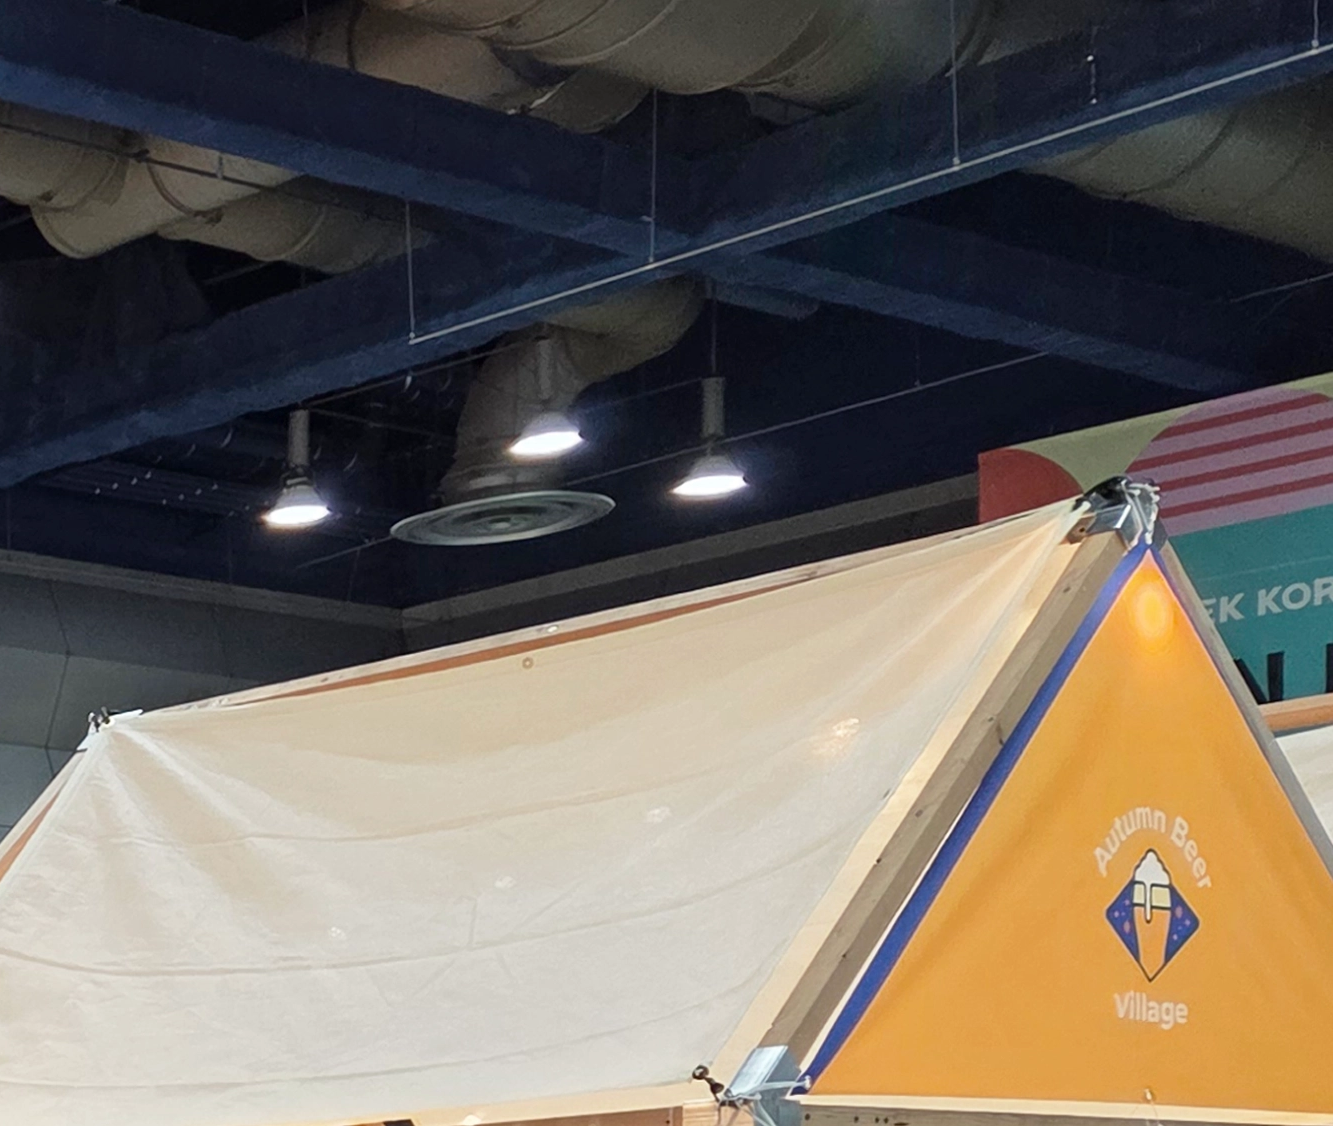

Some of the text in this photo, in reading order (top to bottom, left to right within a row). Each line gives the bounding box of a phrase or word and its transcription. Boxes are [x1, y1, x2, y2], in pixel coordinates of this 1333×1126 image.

[1093, 806, 1213, 889] Autumn Beer
[1114, 992, 1189, 1031] Village
